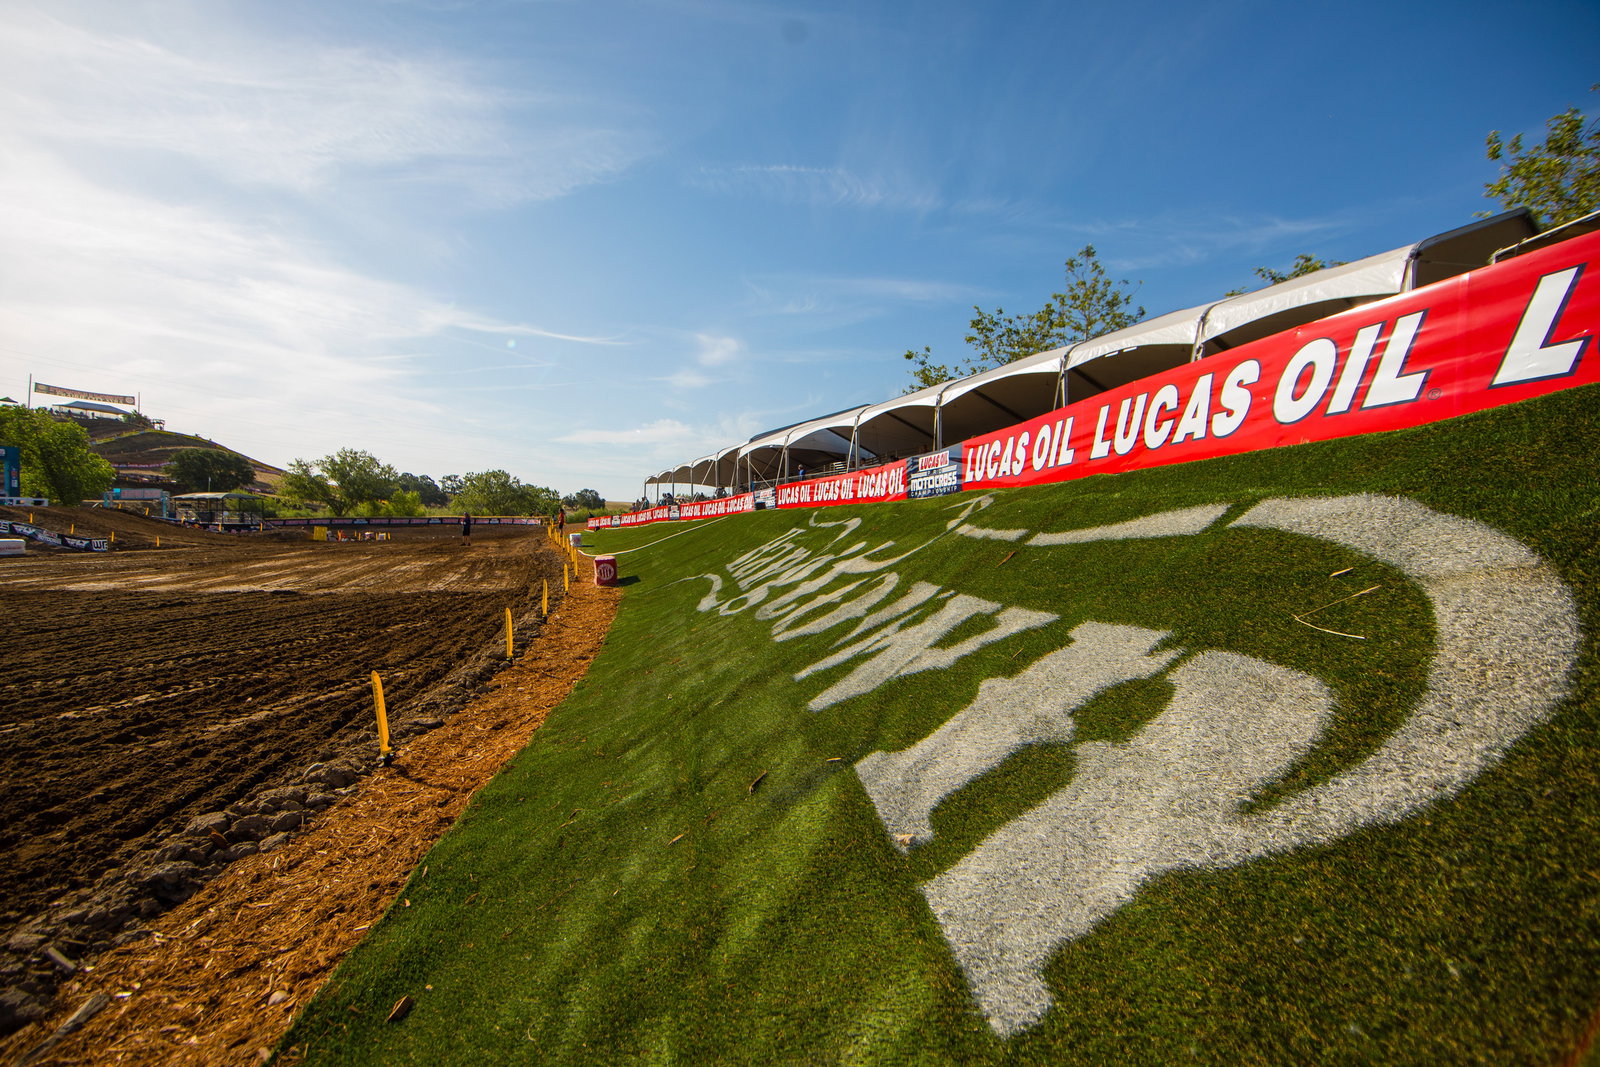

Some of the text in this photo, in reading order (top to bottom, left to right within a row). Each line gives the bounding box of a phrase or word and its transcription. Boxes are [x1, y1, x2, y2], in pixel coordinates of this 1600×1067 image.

[1488, 262, 1600, 389] L
[1089, 308, 1433, 461] LUCAS OIL
[964, 416, 1076, 483] LUCAS OIL
[920, 454, 940, 470] LUCAS
[813, 478, 854, 502] LUCAS OIL
[857, 467, 904, 498] LUCAS OIL
[911, 471, 957, 491] MOTOCROSS
[727, 498, 744, 514] LUCAS
[744, 495, 753, 510] OIL
[778, 485, 799, 505] LUCAS
[800, 483, 811, 503] OIL
[681, 506, 693, 517] LUCAS
[702, 502, 717, 516] LUCAS
